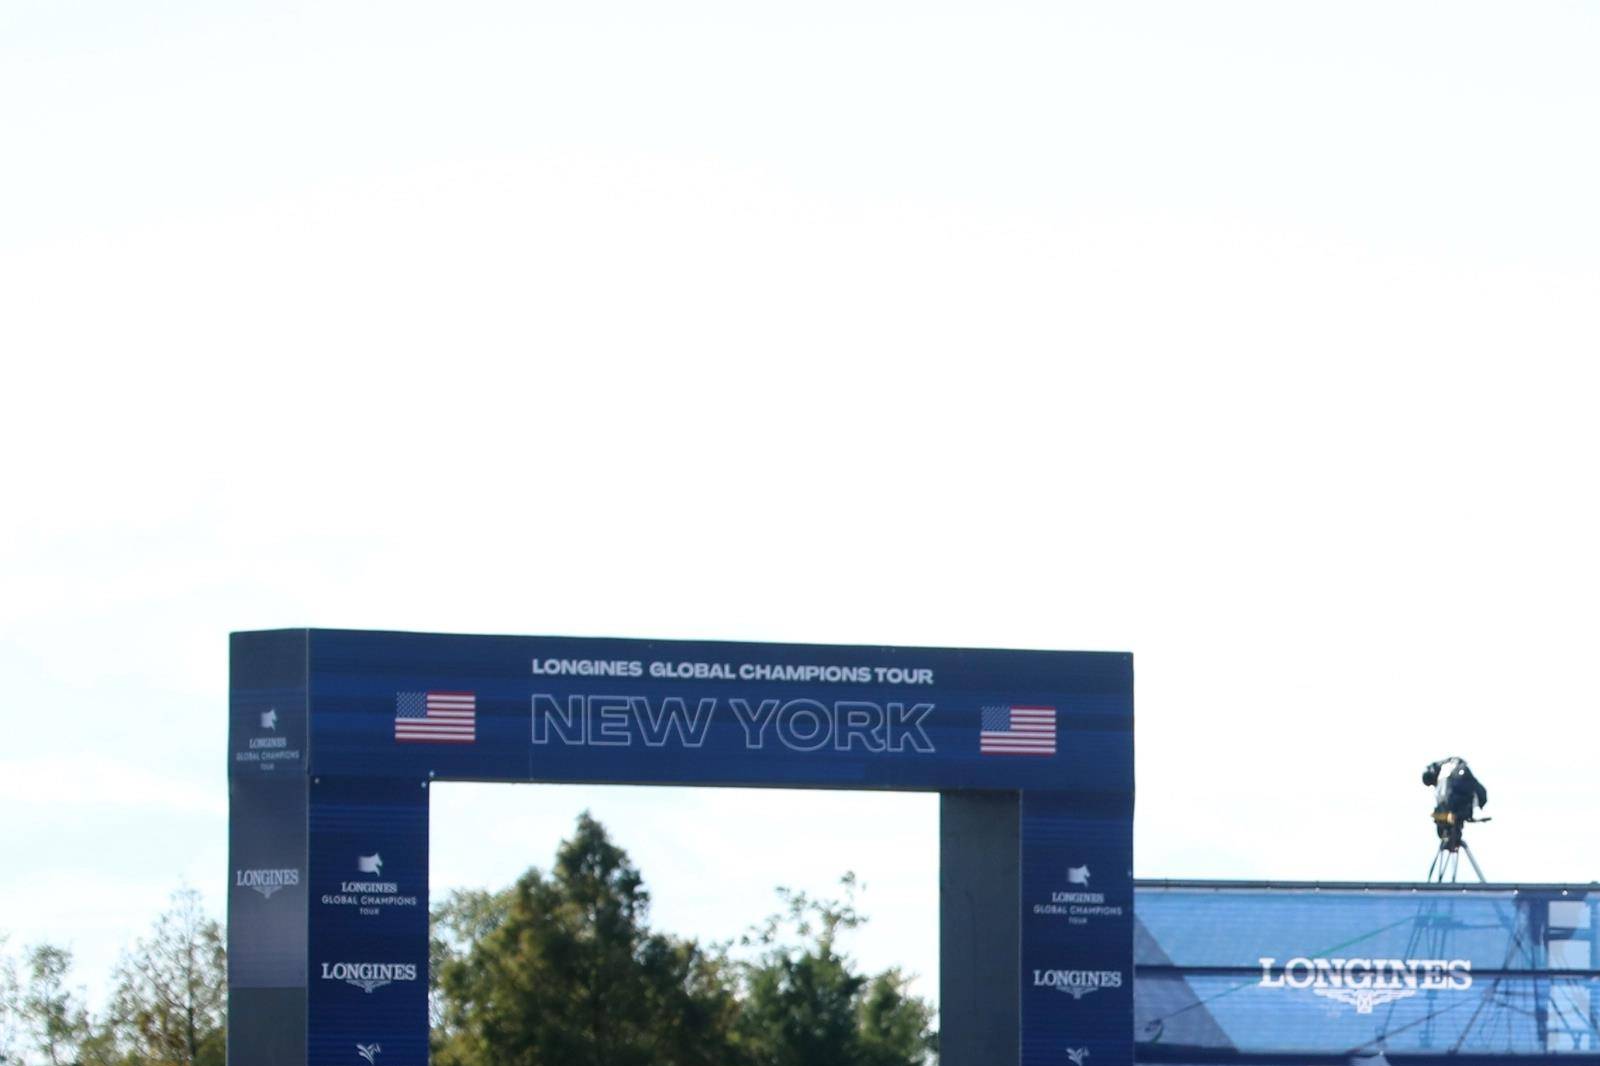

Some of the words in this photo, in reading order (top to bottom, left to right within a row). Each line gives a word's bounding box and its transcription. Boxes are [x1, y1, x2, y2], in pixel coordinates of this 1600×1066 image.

[532, 658, 643, 677] LONGINES
[649, 661, 735, 680] GLOBAL
[739, 664, 872, 683] CHAMPIONS
[874, 667, 934, 685] TOUR
[531, 694, 718, 747] NEW
[728, 698, 937, 753] YORK
[236, 868, 299, 887] LONGINES
[341, 881, 398, 894] LONGINES
[321, 894, 358, 906] GLOBAL
[360, 895, 418, 907] CHAMPIONS
[1051, 891, 1105, 904] LONGINES
[359, 907, 380, 916] TOUR
[1033, 904, 1068, 915] GLOBAL
[1069, 905, 1123, 915] CHAMPIONS
[321, 962, 417, 981] LONGINES
[1033, 969, 1123, 988] LONGINES
[1258, 957, 1473, 990] LONGINES
